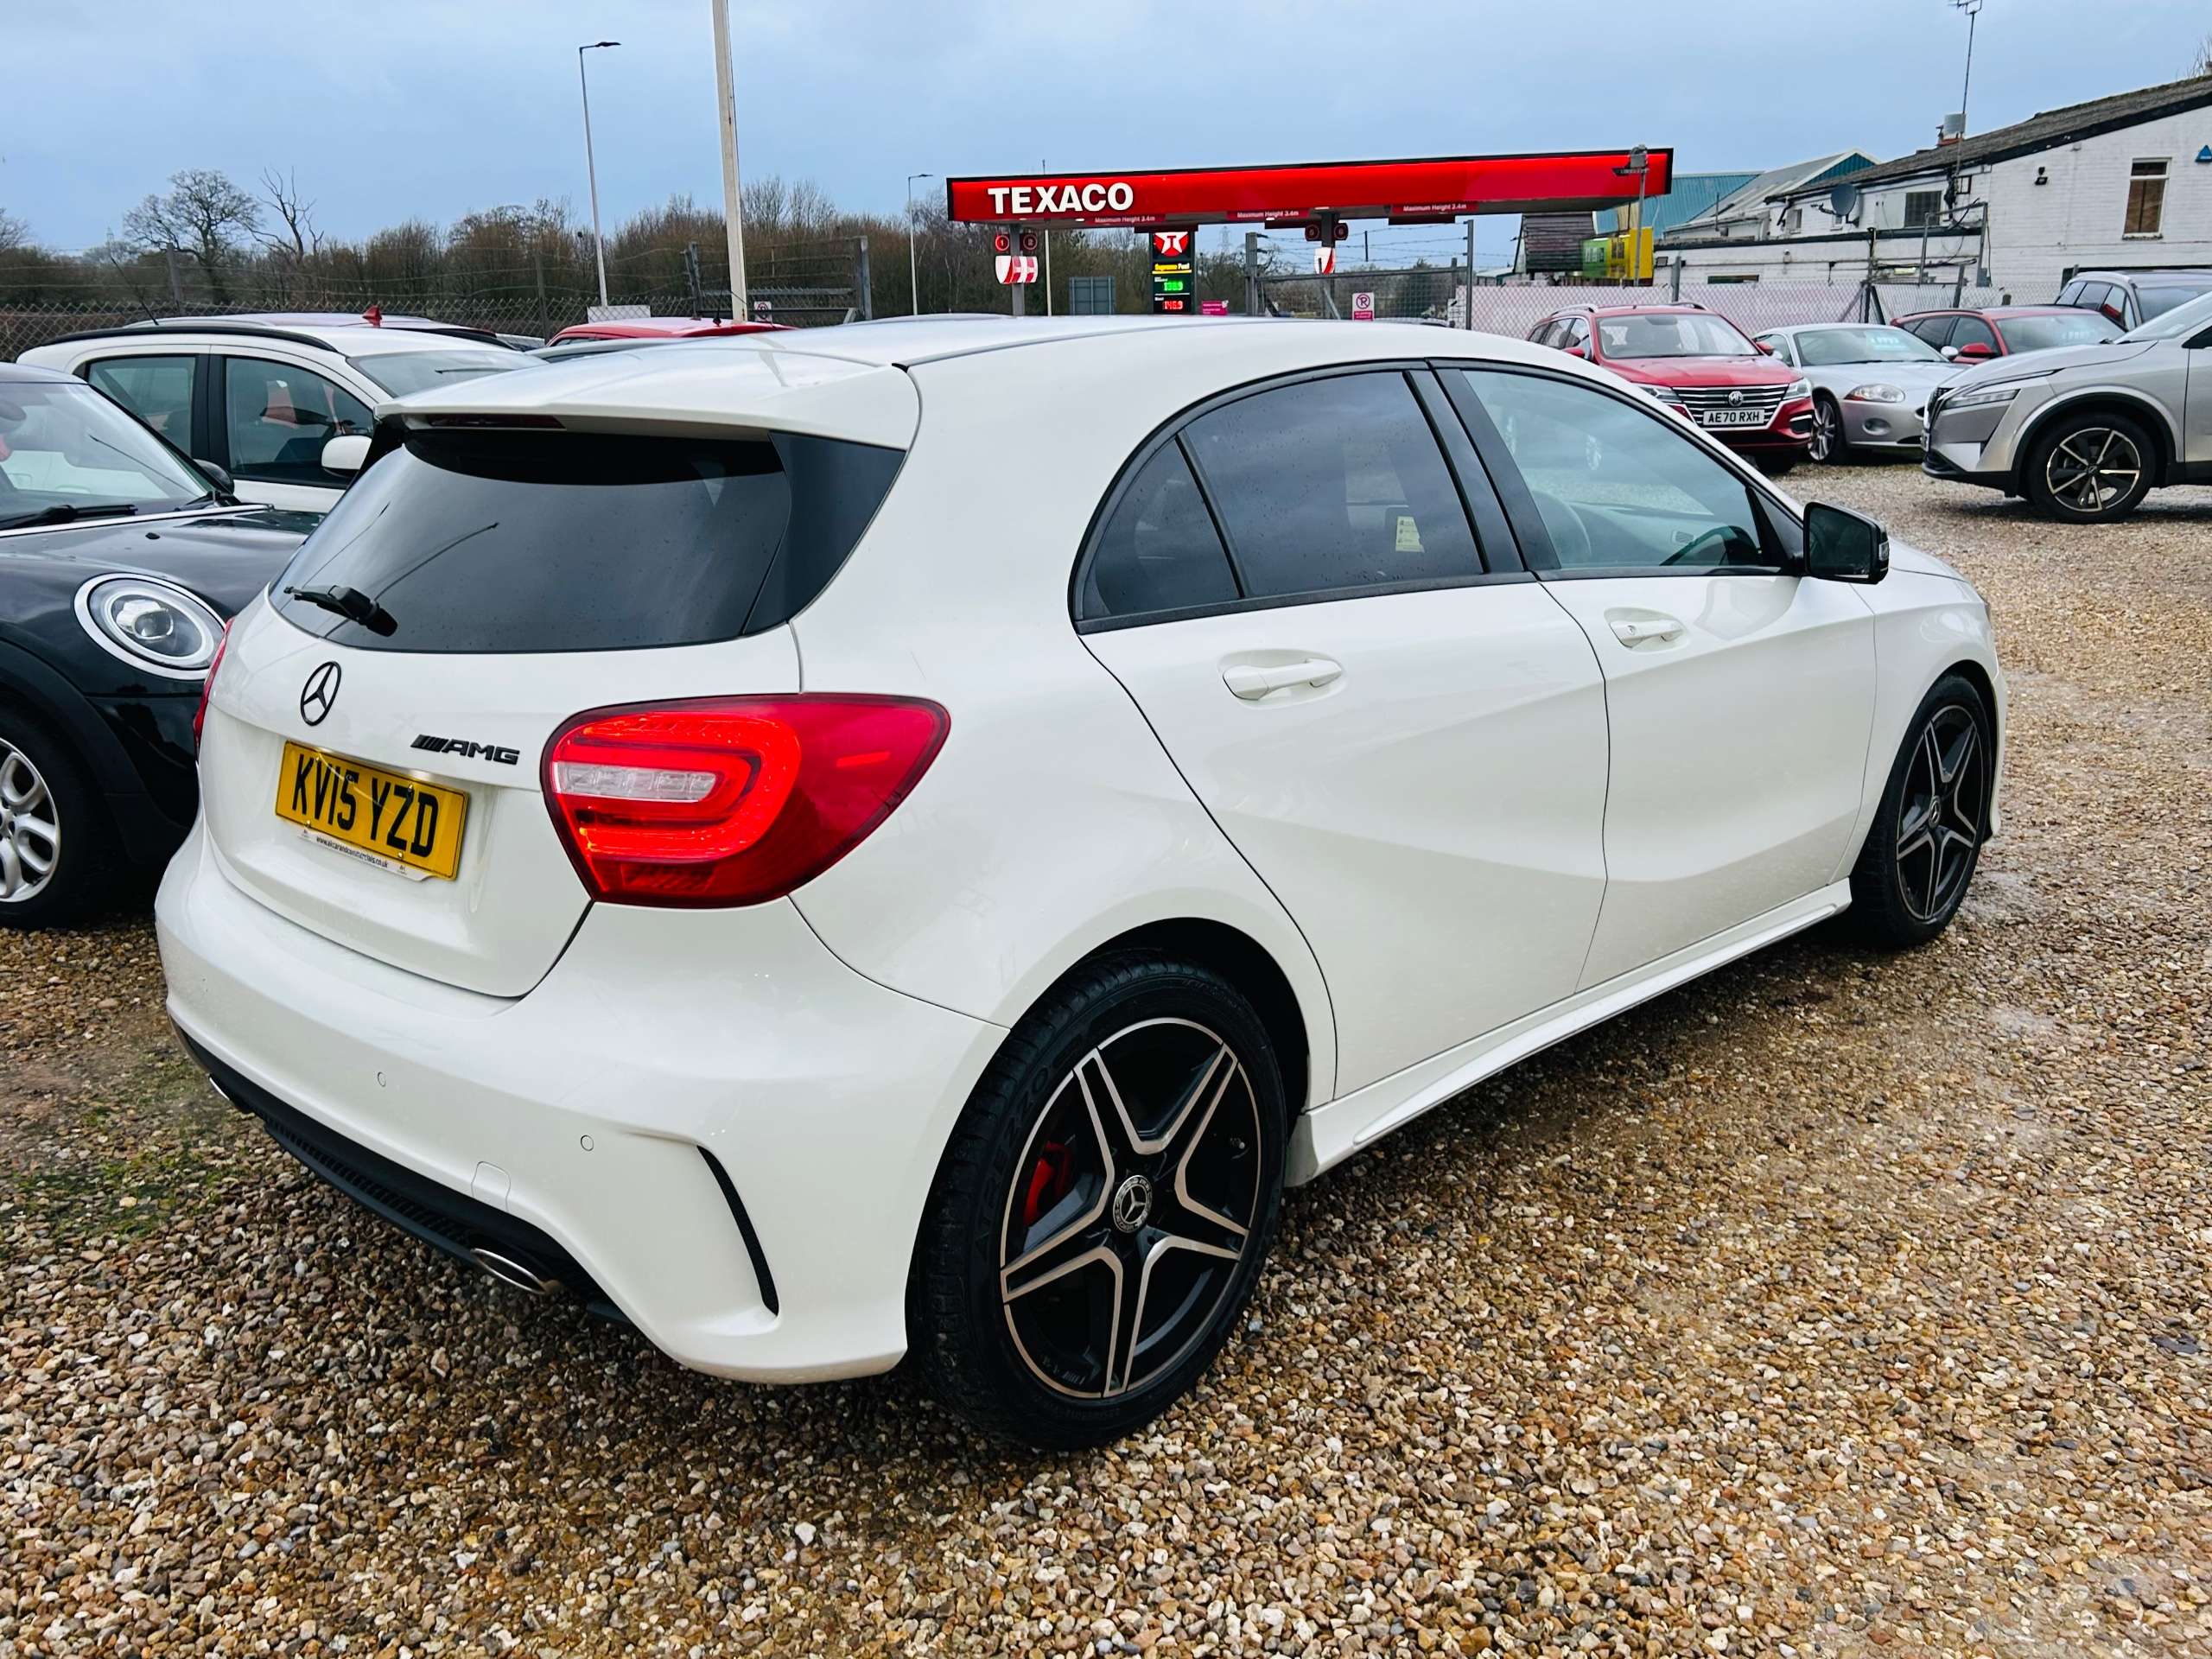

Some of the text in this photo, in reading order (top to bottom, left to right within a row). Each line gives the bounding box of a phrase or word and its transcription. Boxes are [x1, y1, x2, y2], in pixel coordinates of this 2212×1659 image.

[988, 182, 1134, 214] TEXACO
[1707, 411, 1759, 423] AE70 RXH
[442, 740, 520, 766] AMG
[291, 753, 440, 858] KV15 YZD
